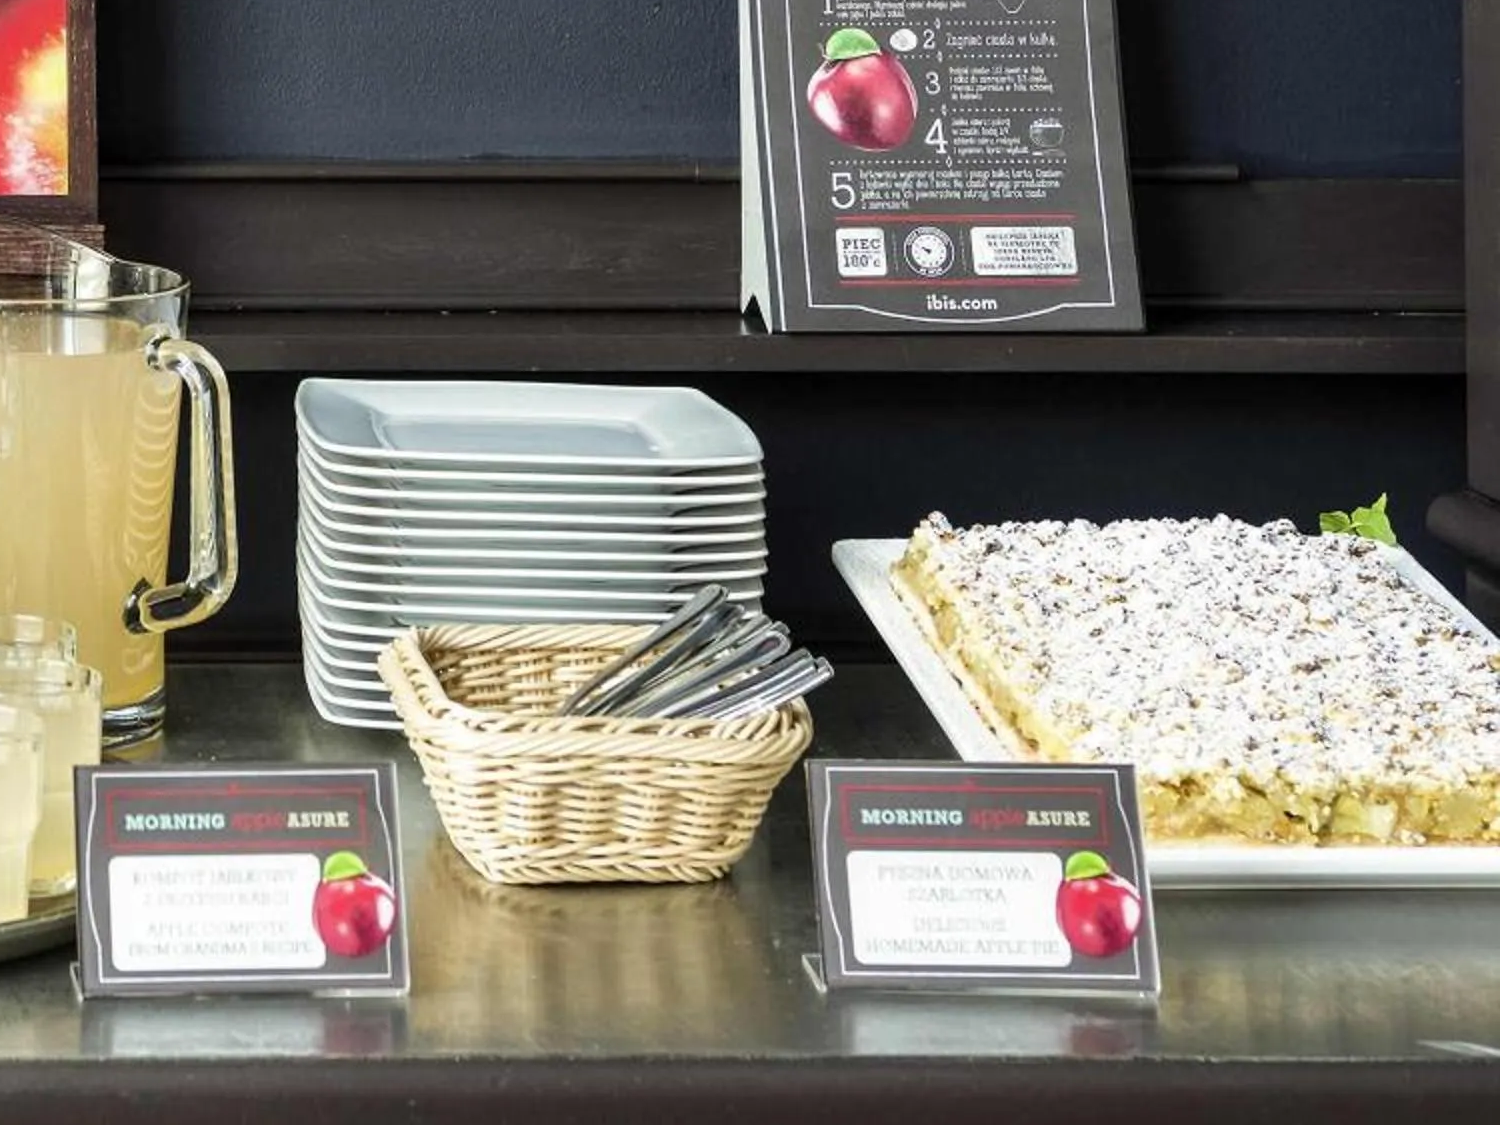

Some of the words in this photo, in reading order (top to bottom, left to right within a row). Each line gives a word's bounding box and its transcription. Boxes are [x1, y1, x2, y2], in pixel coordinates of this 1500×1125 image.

[923, 29, 935, 49] 2
[925, 71, 941, 95] 3
[924, 118, 948, 154] 4
[831, 172, 857, 209] 5
[842, 237, 882, 250] PIEC
[925, 293, 998, 311] ibis.com
[124, 812, 225, 831] MORNING
[860, 808, 964, 827] MORNING
